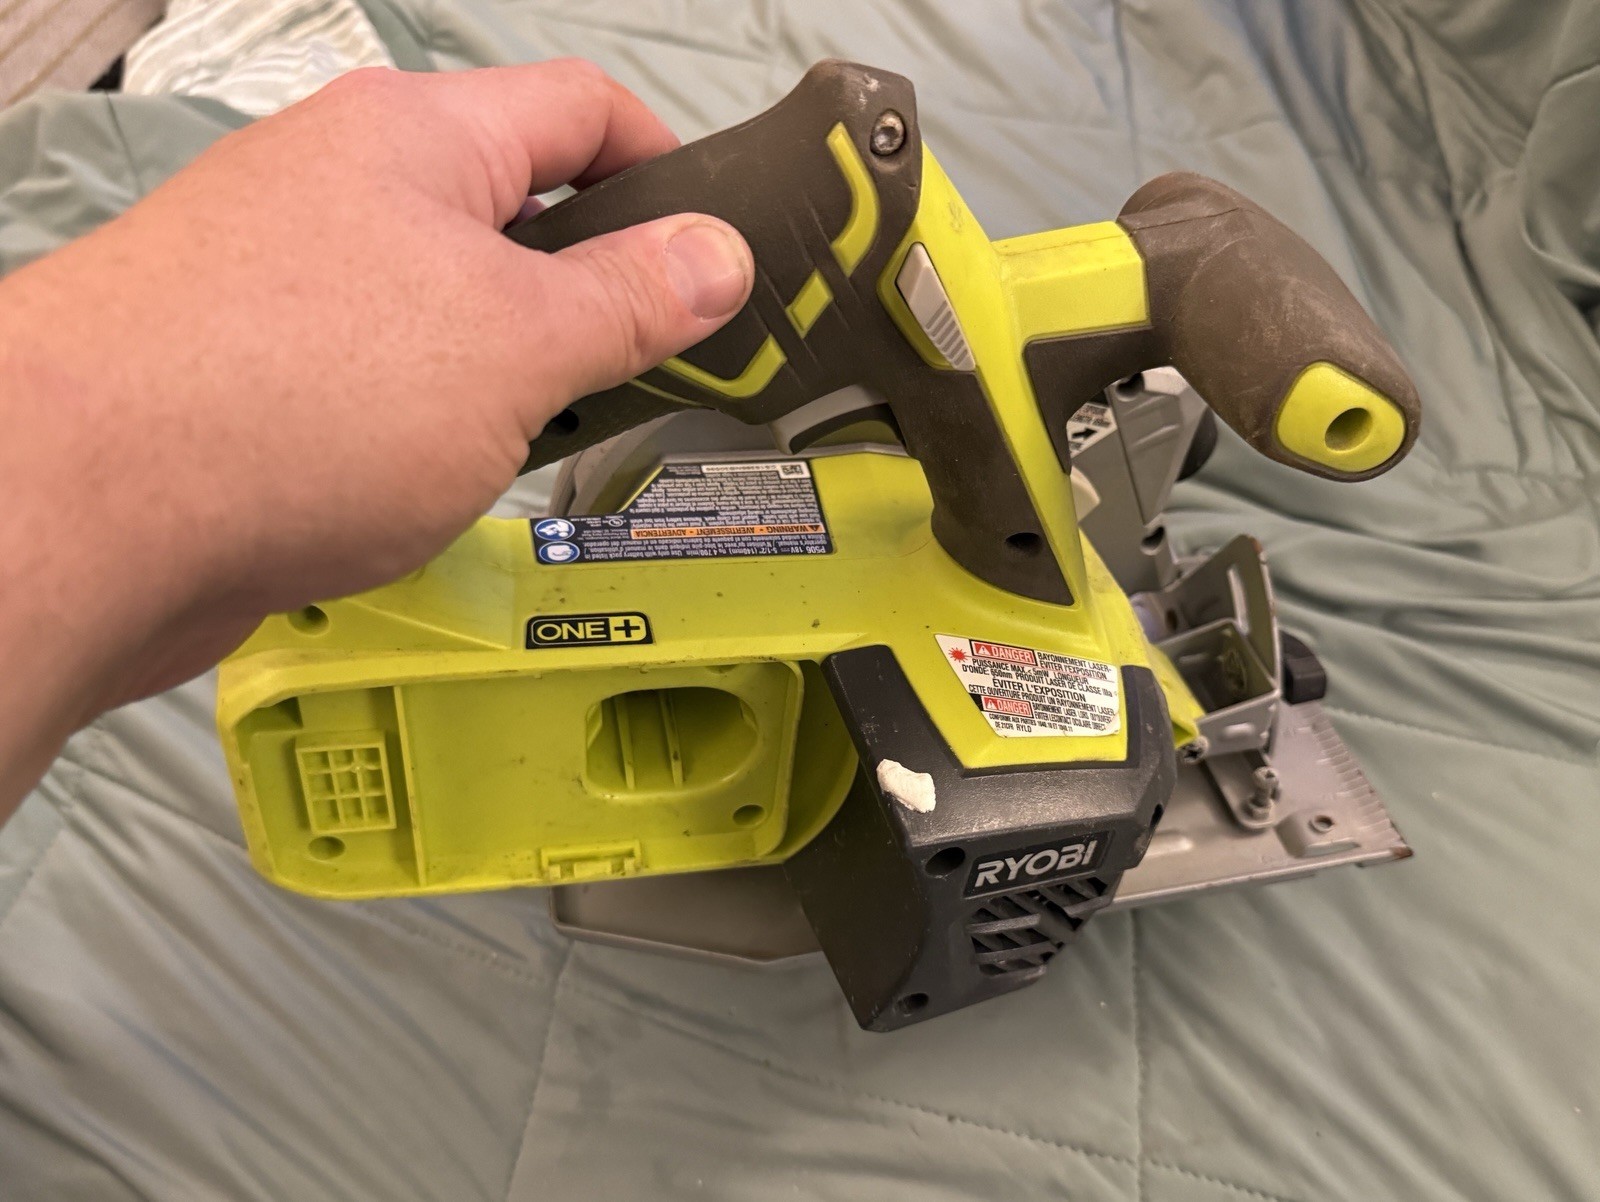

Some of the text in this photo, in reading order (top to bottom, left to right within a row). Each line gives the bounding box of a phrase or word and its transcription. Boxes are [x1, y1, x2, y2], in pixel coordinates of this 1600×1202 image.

[635, 530, 686, 538] ADVERTENCIA
[697, 527, 754, 535] AVERTISSEMENT
[991, 645, 1032, 665] DANGER
[972, 659, 1010, 671] PUISSANCE
[1054, 672, 1089, 685] LONGUEUR
[1016, 671, 1044, 684] PRODUIT
[1046, 676, 1068, 689] LASER
[1068, 681, 1077, 691] DE
[1077, 682, 1102, 696] CLASSE
[1026, 684, 1087, 703] L'EXPOSITION
[969, 684, 988, 695] CETTE
[987, 687, 1022, 700] OUVERTURE
[1021, 691, 1046, 704] PRODUIT
[997, 699, 1031, 716] DANGER
[974, 840, 1098, 888] RYOBI
